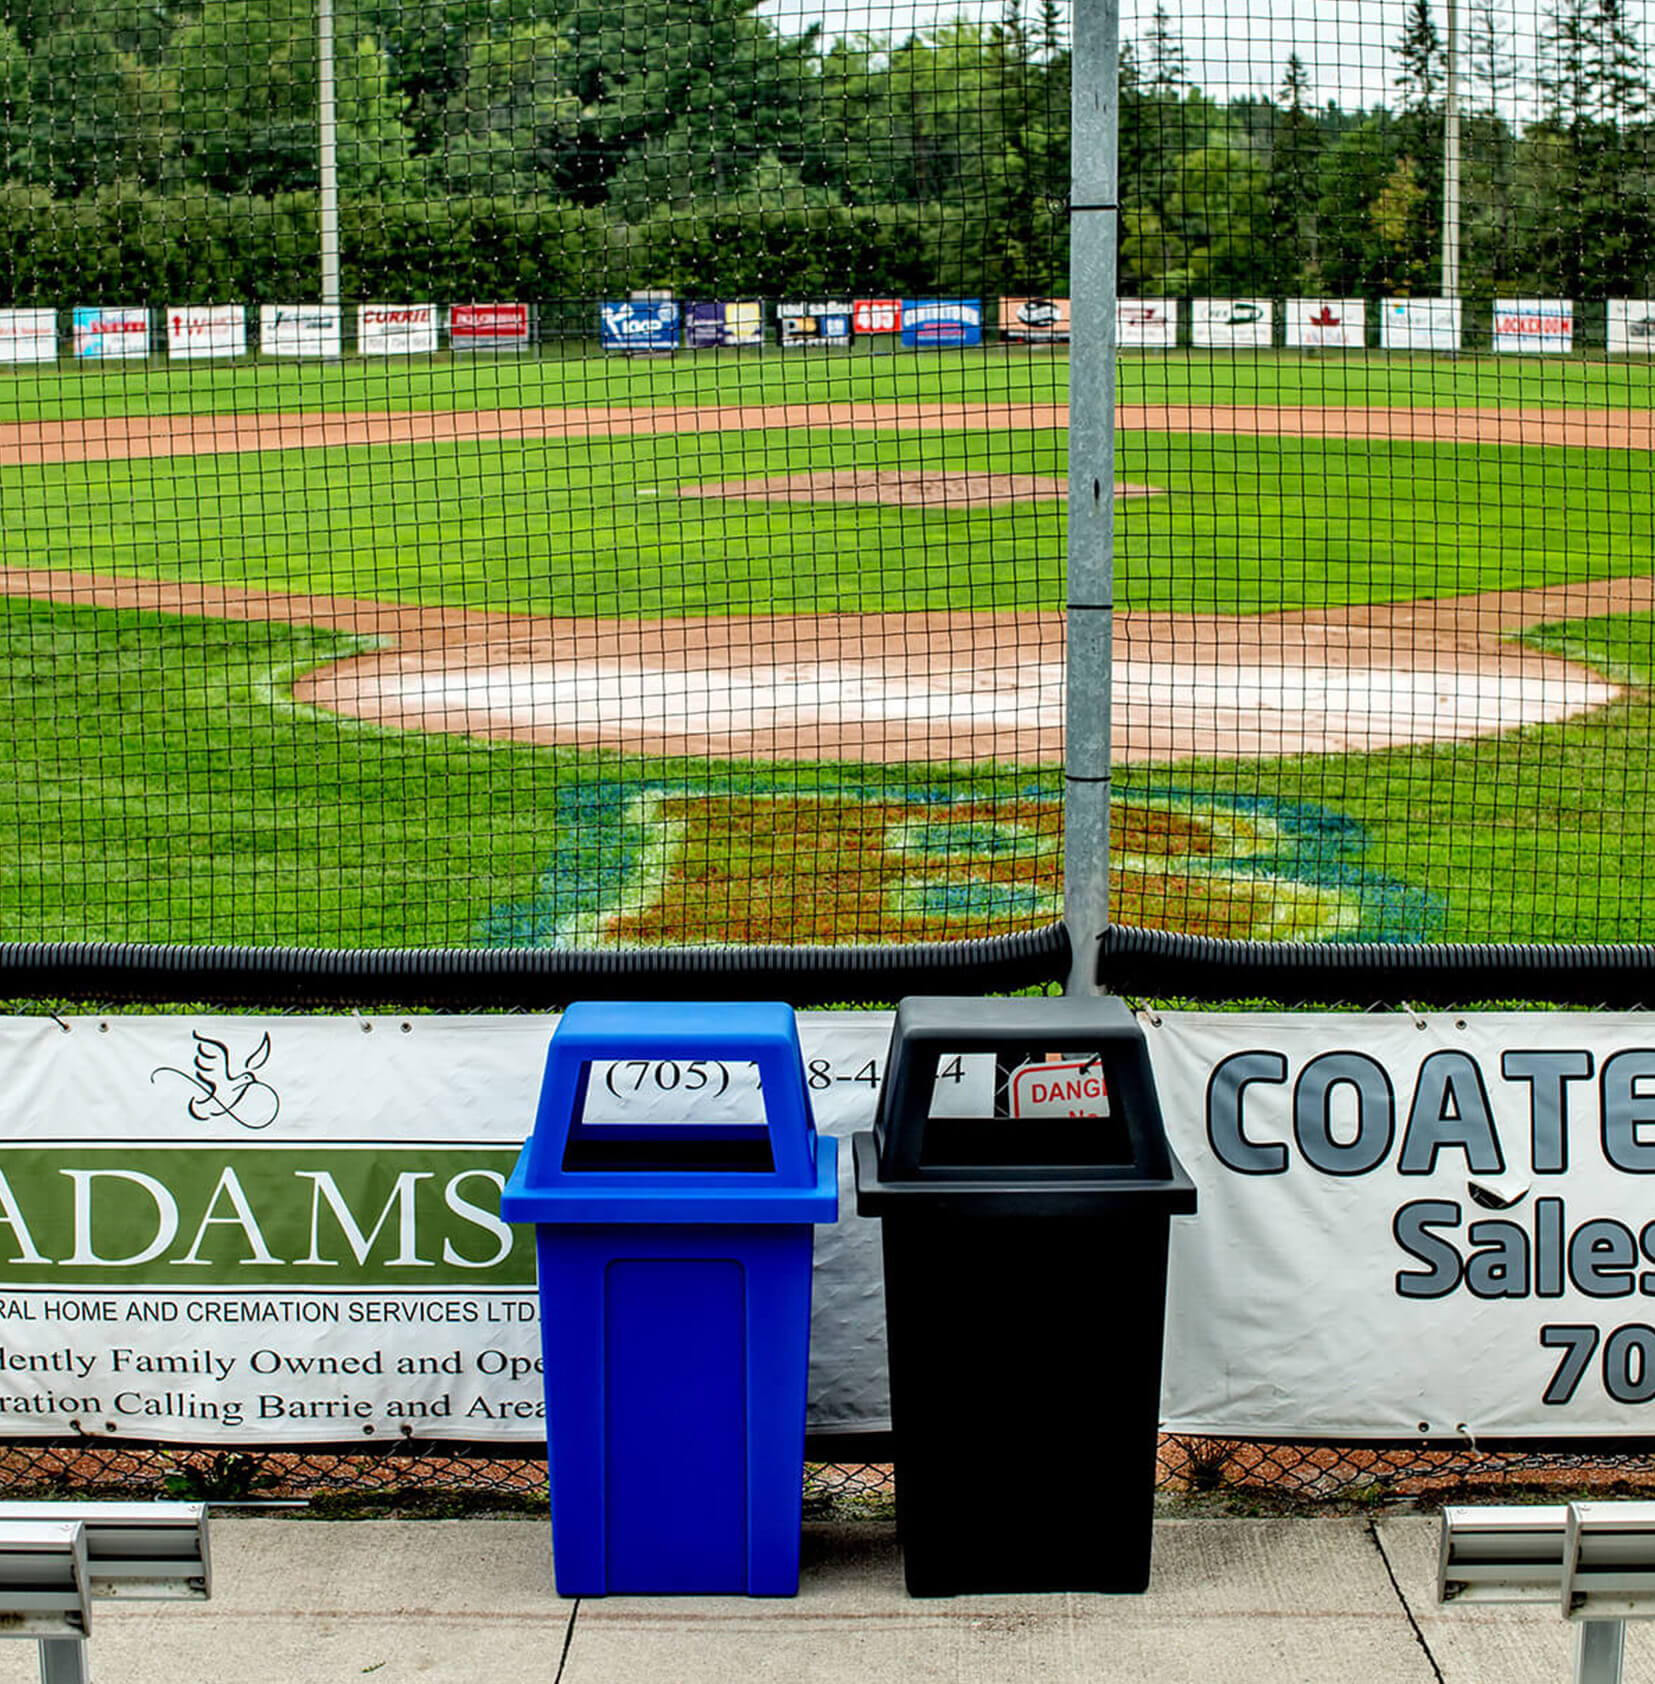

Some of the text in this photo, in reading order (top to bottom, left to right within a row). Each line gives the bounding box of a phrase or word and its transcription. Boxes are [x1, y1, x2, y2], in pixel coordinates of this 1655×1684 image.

[606, 1061, 730, 1099] (705)
[1032, 1078, 1107, 1104] DANG
[1206, 1049, 1655, 1177] COATE
[44, 1300, 118, 1322] HOME
[125, 1301, 178, 1322] AND
[186, 1301, 340, 1323] CREMATION
[348, 1301, 479, 1323] SERVICES
[112, 1349, 236, 1383] Family
[250, 1350, 384, 1375] Owned
[397, 1350, 464, 1375] and
[1540, 1323, 1655, 1406] 70
[0, 1391, 102, 1414] ration
[113, 1392, 244, 1429] Calling
[259, 1394, 374, 1420] Barrie
[386, 1394, 453, 1419] and
